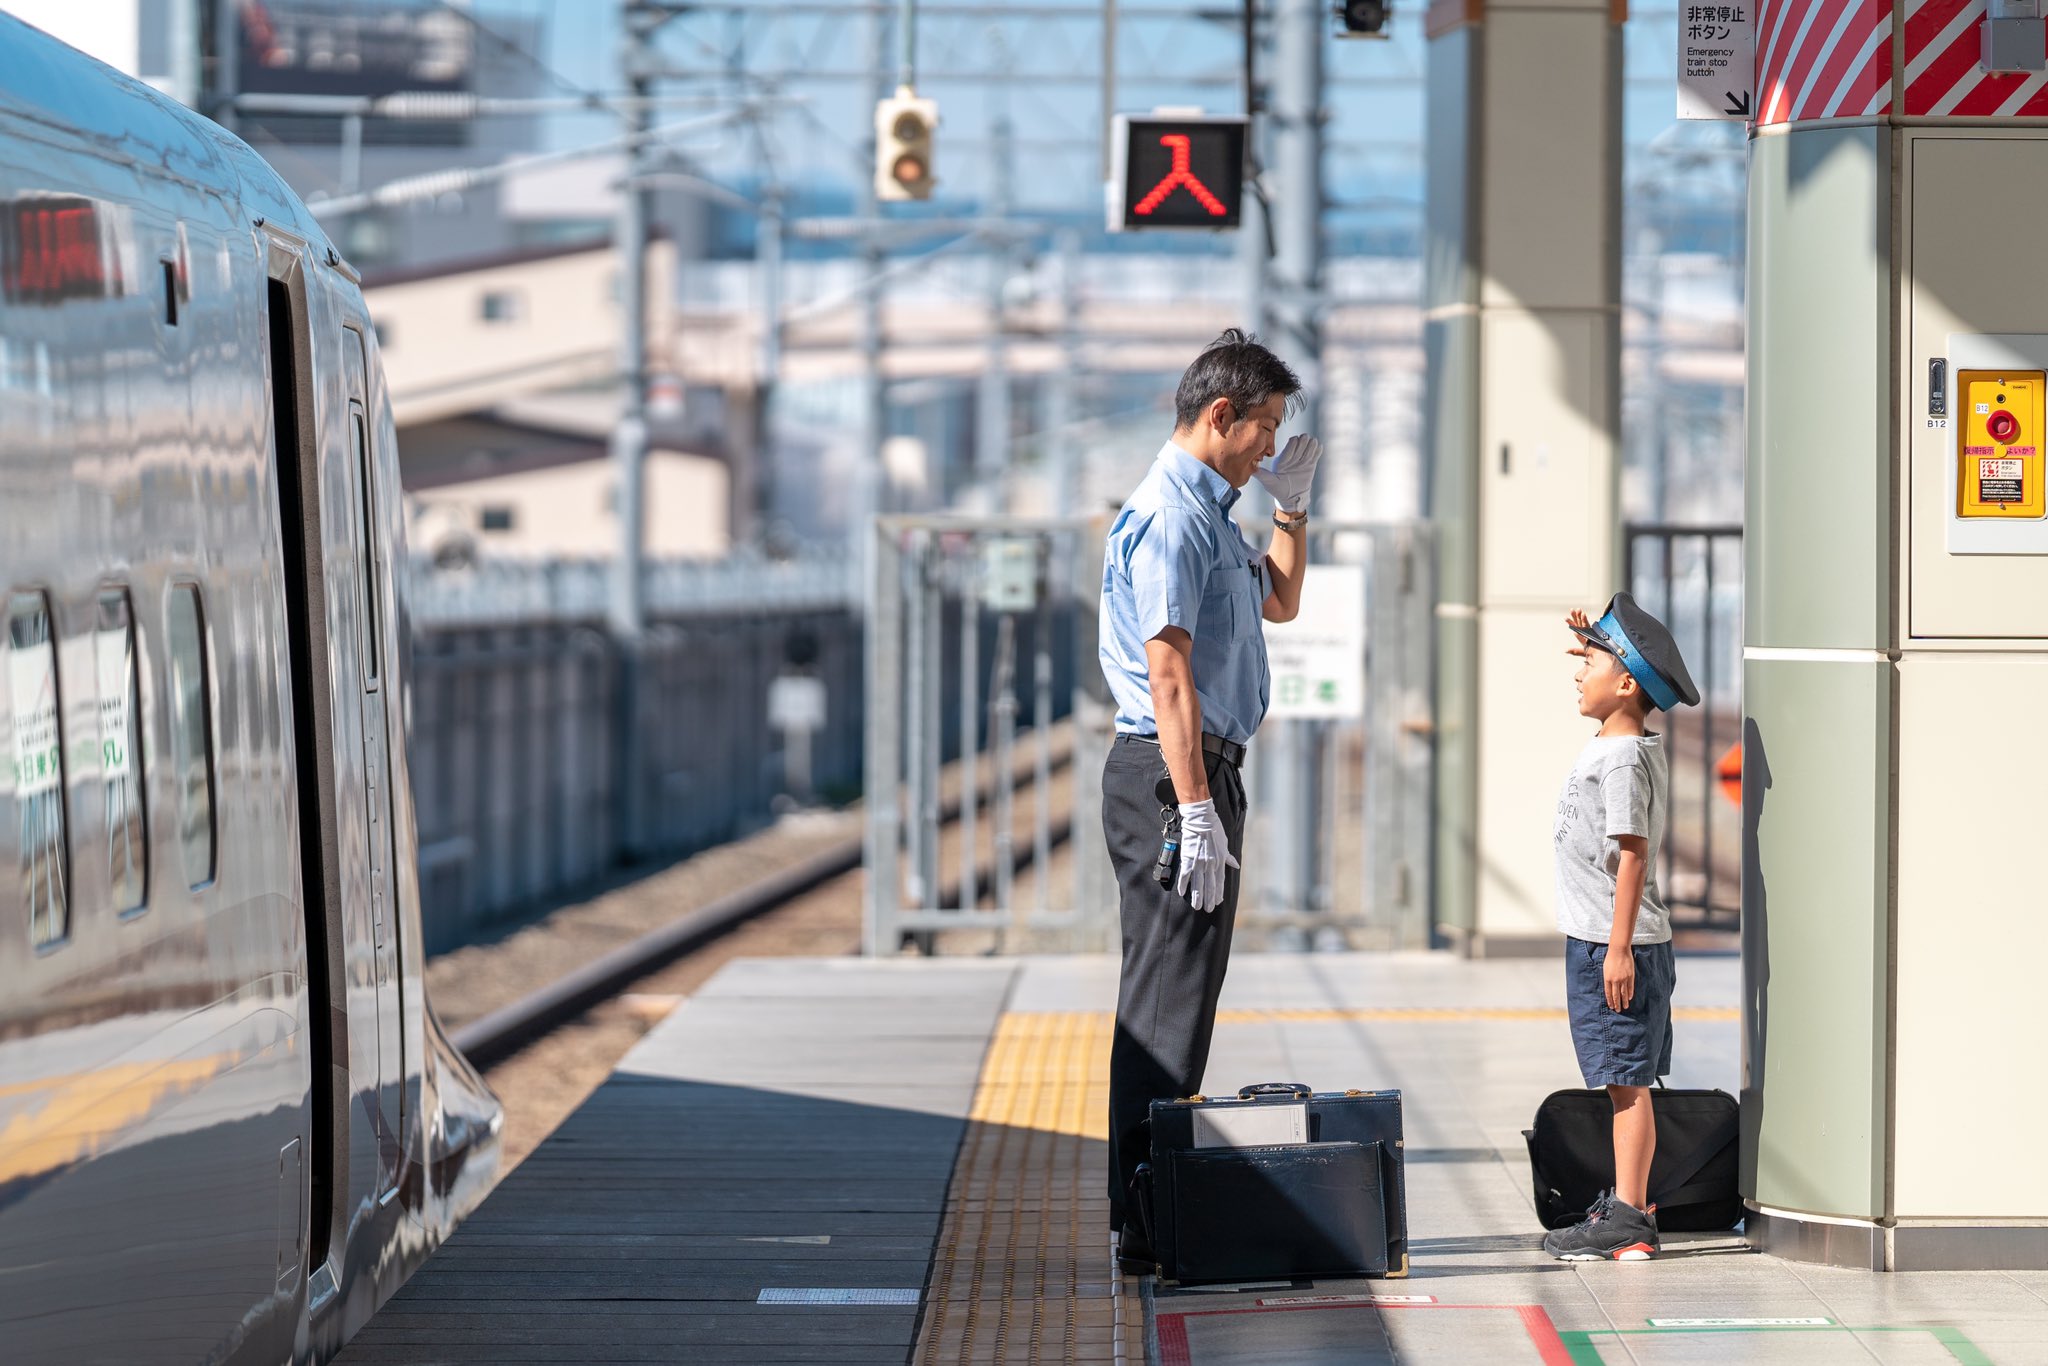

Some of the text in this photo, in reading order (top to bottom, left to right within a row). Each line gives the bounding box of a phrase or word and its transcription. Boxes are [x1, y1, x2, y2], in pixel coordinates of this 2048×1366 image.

[1687, 5, 1745, 22] 非常停止
[1688, 24, 1731, 40] ボタン
[1687, 47, 1734, 57] Emergency
[1687, 57, 1728, 67] train stop
[1687, 67, 1715, 76] button
[1976, 404, 1988, 412] B12
[1927, 419, 1946, 428] B12
[1555, 819, 1572, 845] MNT
